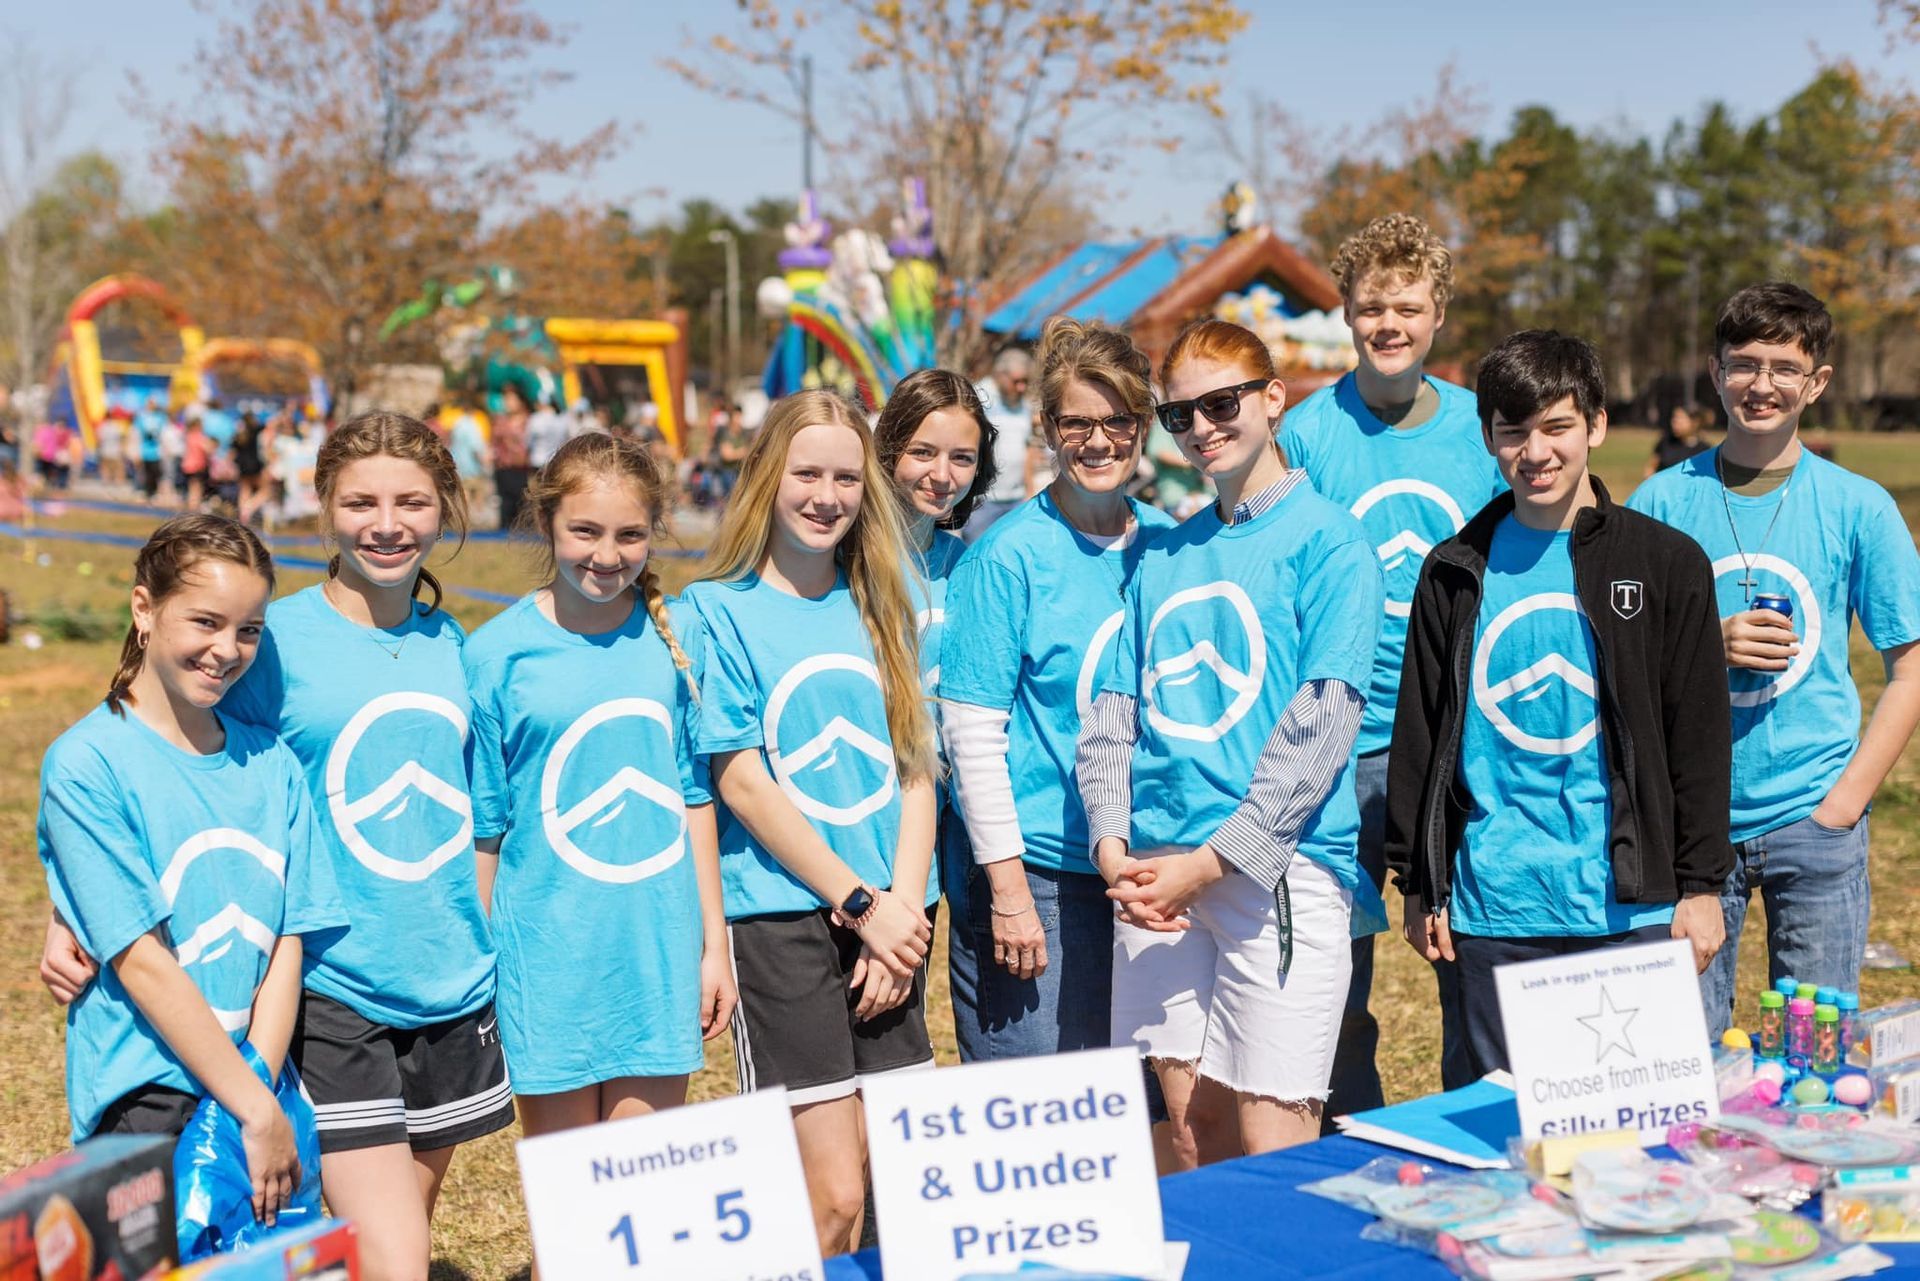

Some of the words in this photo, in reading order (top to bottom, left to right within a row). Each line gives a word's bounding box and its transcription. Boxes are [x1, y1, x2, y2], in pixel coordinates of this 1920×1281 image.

[1617, 585, 1637, 609] T
[1521, 977, 1548, 990] Look
[1552, 975, 1562, 985] in
[1565, 972, 1591, 985] eggs
[1594, 968, 1609, 979] for
[1612, 965, 1632, 976] this
[1531, 1072, 1604, 1104] Choose
[1608, 1064, 1650, 1090] from
[1653, 1056, 1702, 1083] these
[891, 1103, 967, 1141] 1st
[985, 1086, 1127, 1130] Grade
[1617, 1100, 1708, 1131] Prizes
[590, 1135, 738, 1183] Numbers
[920, 1166, 953, 1201] &
[974, 1152, 1118, 1194] Under
[609, 1214, 640, 1267] 1
[672, 1229, 690, 1243] -
[714, 1189, 752, 1243] 5
[952, 1217, 1100, 1260] Prizes
